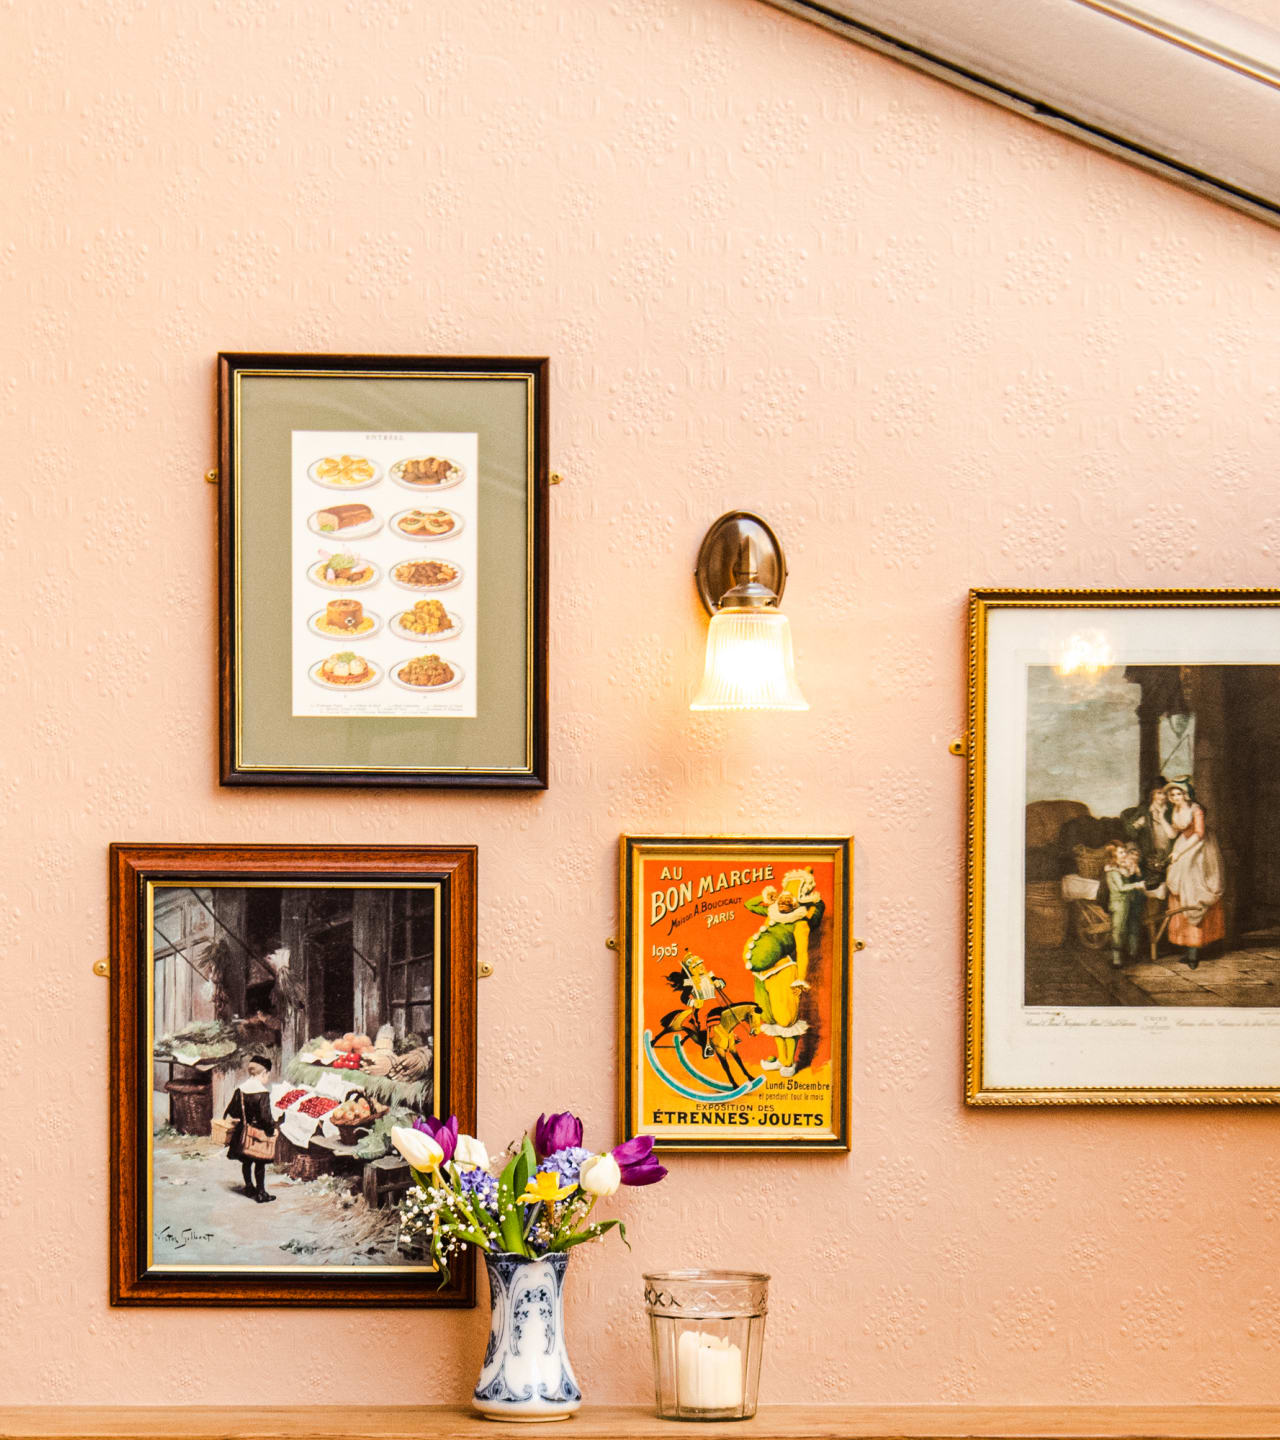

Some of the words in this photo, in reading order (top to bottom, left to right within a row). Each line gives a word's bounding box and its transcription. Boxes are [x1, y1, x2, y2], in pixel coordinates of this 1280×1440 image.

[660, 866, 683, 881] AU
[650, 880, 693, 927] BON
[697, 864, 775, 899] MARCHÉ
[704, 911, 735, 928] PARIS
[652, 943, 678, 962] 1905
[766, 1081, 785, 1090] Lundi
[786, 1079, 793, 1090] 5
[696, 1104, 753, 1112] EXPOSITION
[653, 1109, 749, 1125] ÉTRENNES
[758, 1113, 824, 1126] JOUETS
